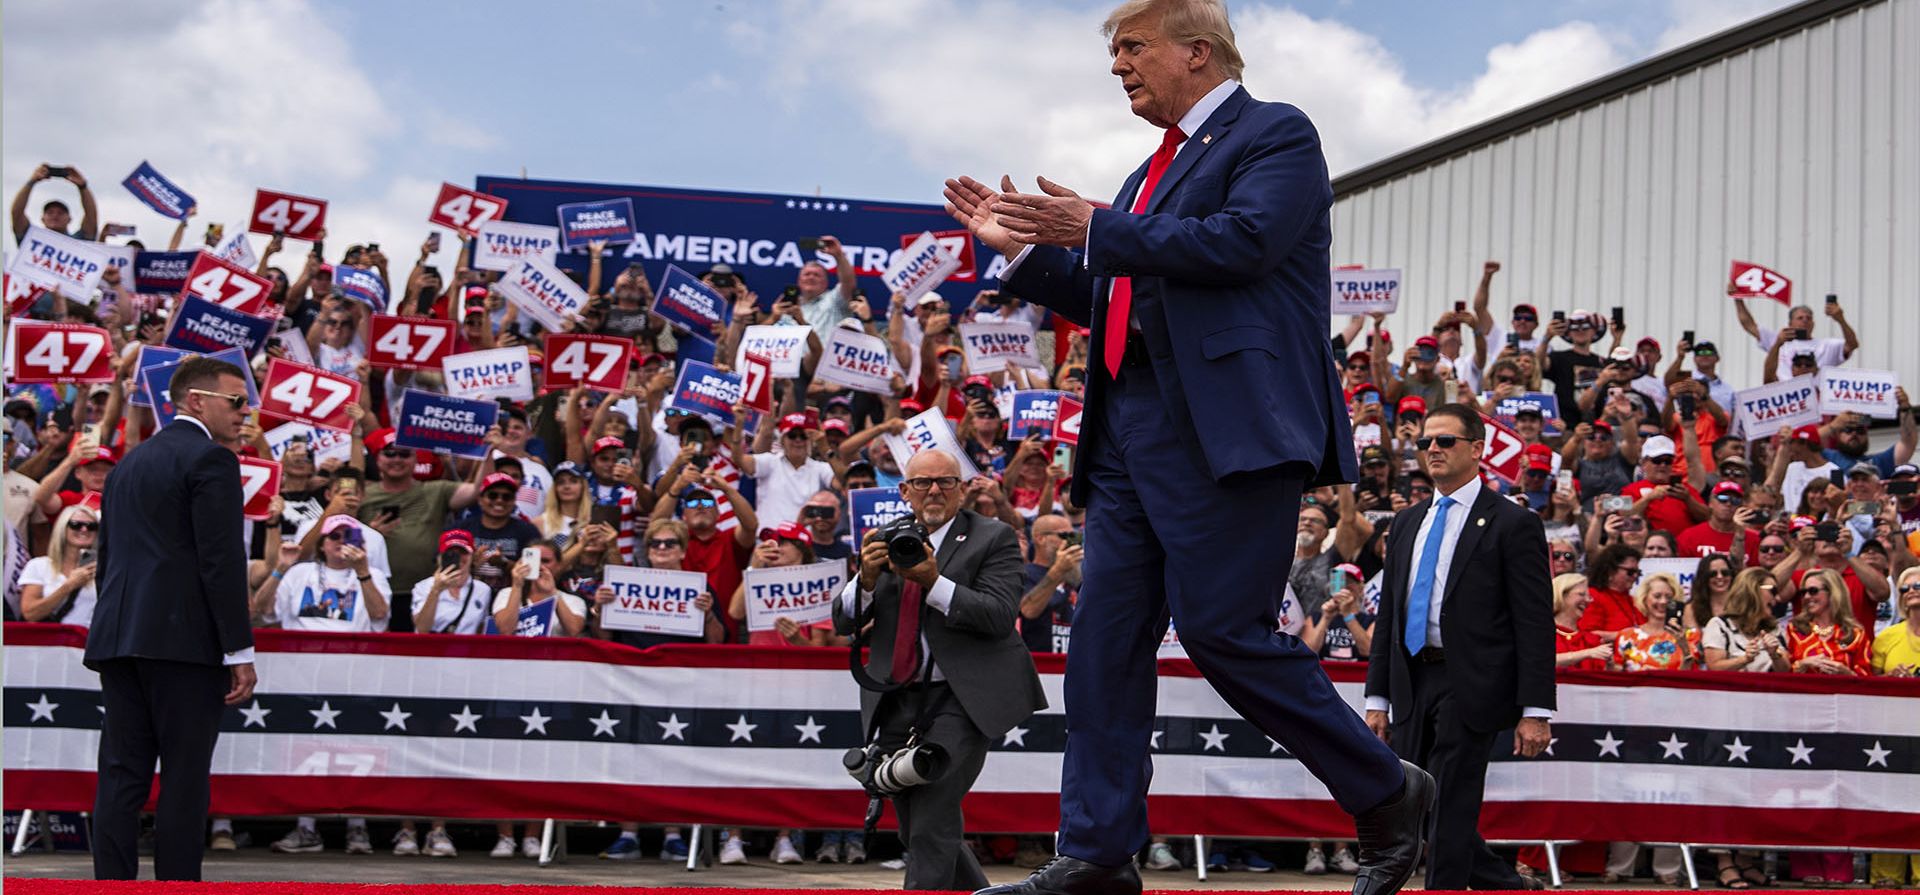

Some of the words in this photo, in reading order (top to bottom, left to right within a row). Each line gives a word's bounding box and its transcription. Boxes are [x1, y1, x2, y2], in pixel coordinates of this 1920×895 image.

[258, 199, 320, 233] 47
[439, 194, 500, 230] 47
[577, 210, 616, 222] PEACE
[485, 232, 552, 249] TRUMP
[623, 232, 804, 268] AMERICA
[30, 239, 98, 273] TRUMP
[891, 244, 938, 288] TRUMP
[32, 254, 87, 282] VANCE
[903, 256, 941, 290] VANCE
[190, 266, 262, 310] 47
[522, 262, 577, 309] TRUMP
[1336, 280, 1398, 292] TRUMP
[1735, 267, 1787, 295] 47
[520, 276, 566, 314] VANCE
[668, 287, 720, 321] THROUGH
[679, 283, 715, 308] PEACE
[1342, 291, 1391, 301] VANCE
[185, 317, 256, 349] THROUGH
[201, 312, 251, 336] PEACE
[375, 323, 447, 362] 47
[747, 337, 799, 349] TRUMP
[968, 334, 1031, 347] TRUMP
[979, 344, 1027, 355] VANCE
[24, 331, 105, 374] 47
[551, 341, 624, 382] 47
[450, 361, 524, 381] TRUMP
[836, 356, 889, 377] VANCE
[459, 373, 516, 389] VANCE
[688, 380, 740, 403] THROU
[702, 374, 741, 392] PEAC
[1826, 378, 1892, 393] TRUMP
[270, 371, 352, 419] 47
[1031, 400, 1058, 410] PEA
[1744, 388, 1811, 412] TRUMP
[1833, 390, 1885, 401] VANCE
[424, 405, 476, 423] PEACE
[1754, 401, 1808, 421] VANCE
[410, 414, 486, 435] THROUGH
[874, 500, 914, 513] PEAC
[611, 582, 698, 601] TRUMP
[752, 575, 840, 598] TRUMP
[620, 597, 688, 613] VANCE
[763, 590, 831, 609] VANCE
